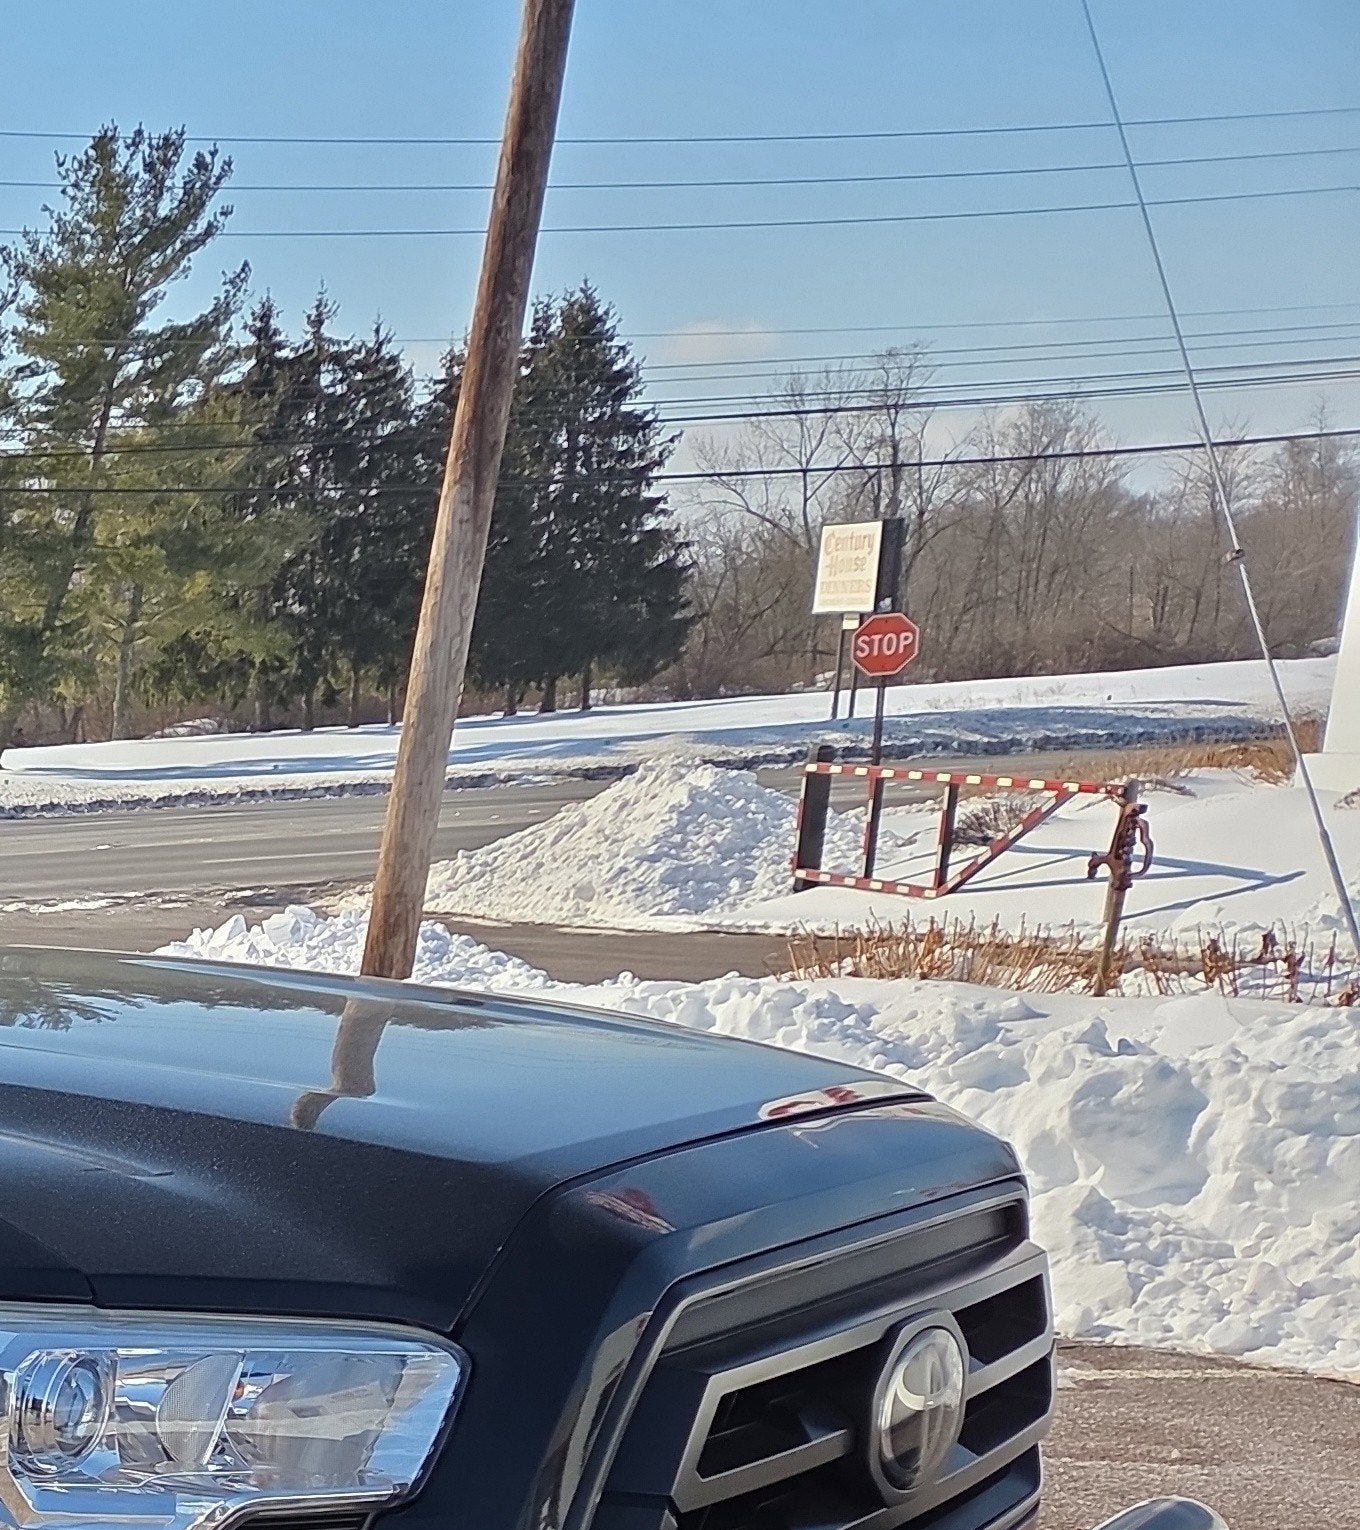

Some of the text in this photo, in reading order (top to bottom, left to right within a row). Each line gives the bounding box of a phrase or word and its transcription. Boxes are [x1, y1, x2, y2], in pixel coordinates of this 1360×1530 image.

[824, 530, 875, 556] Century
[825, 556, 867, 577] House
[856, 632, 914, 658] STOP
